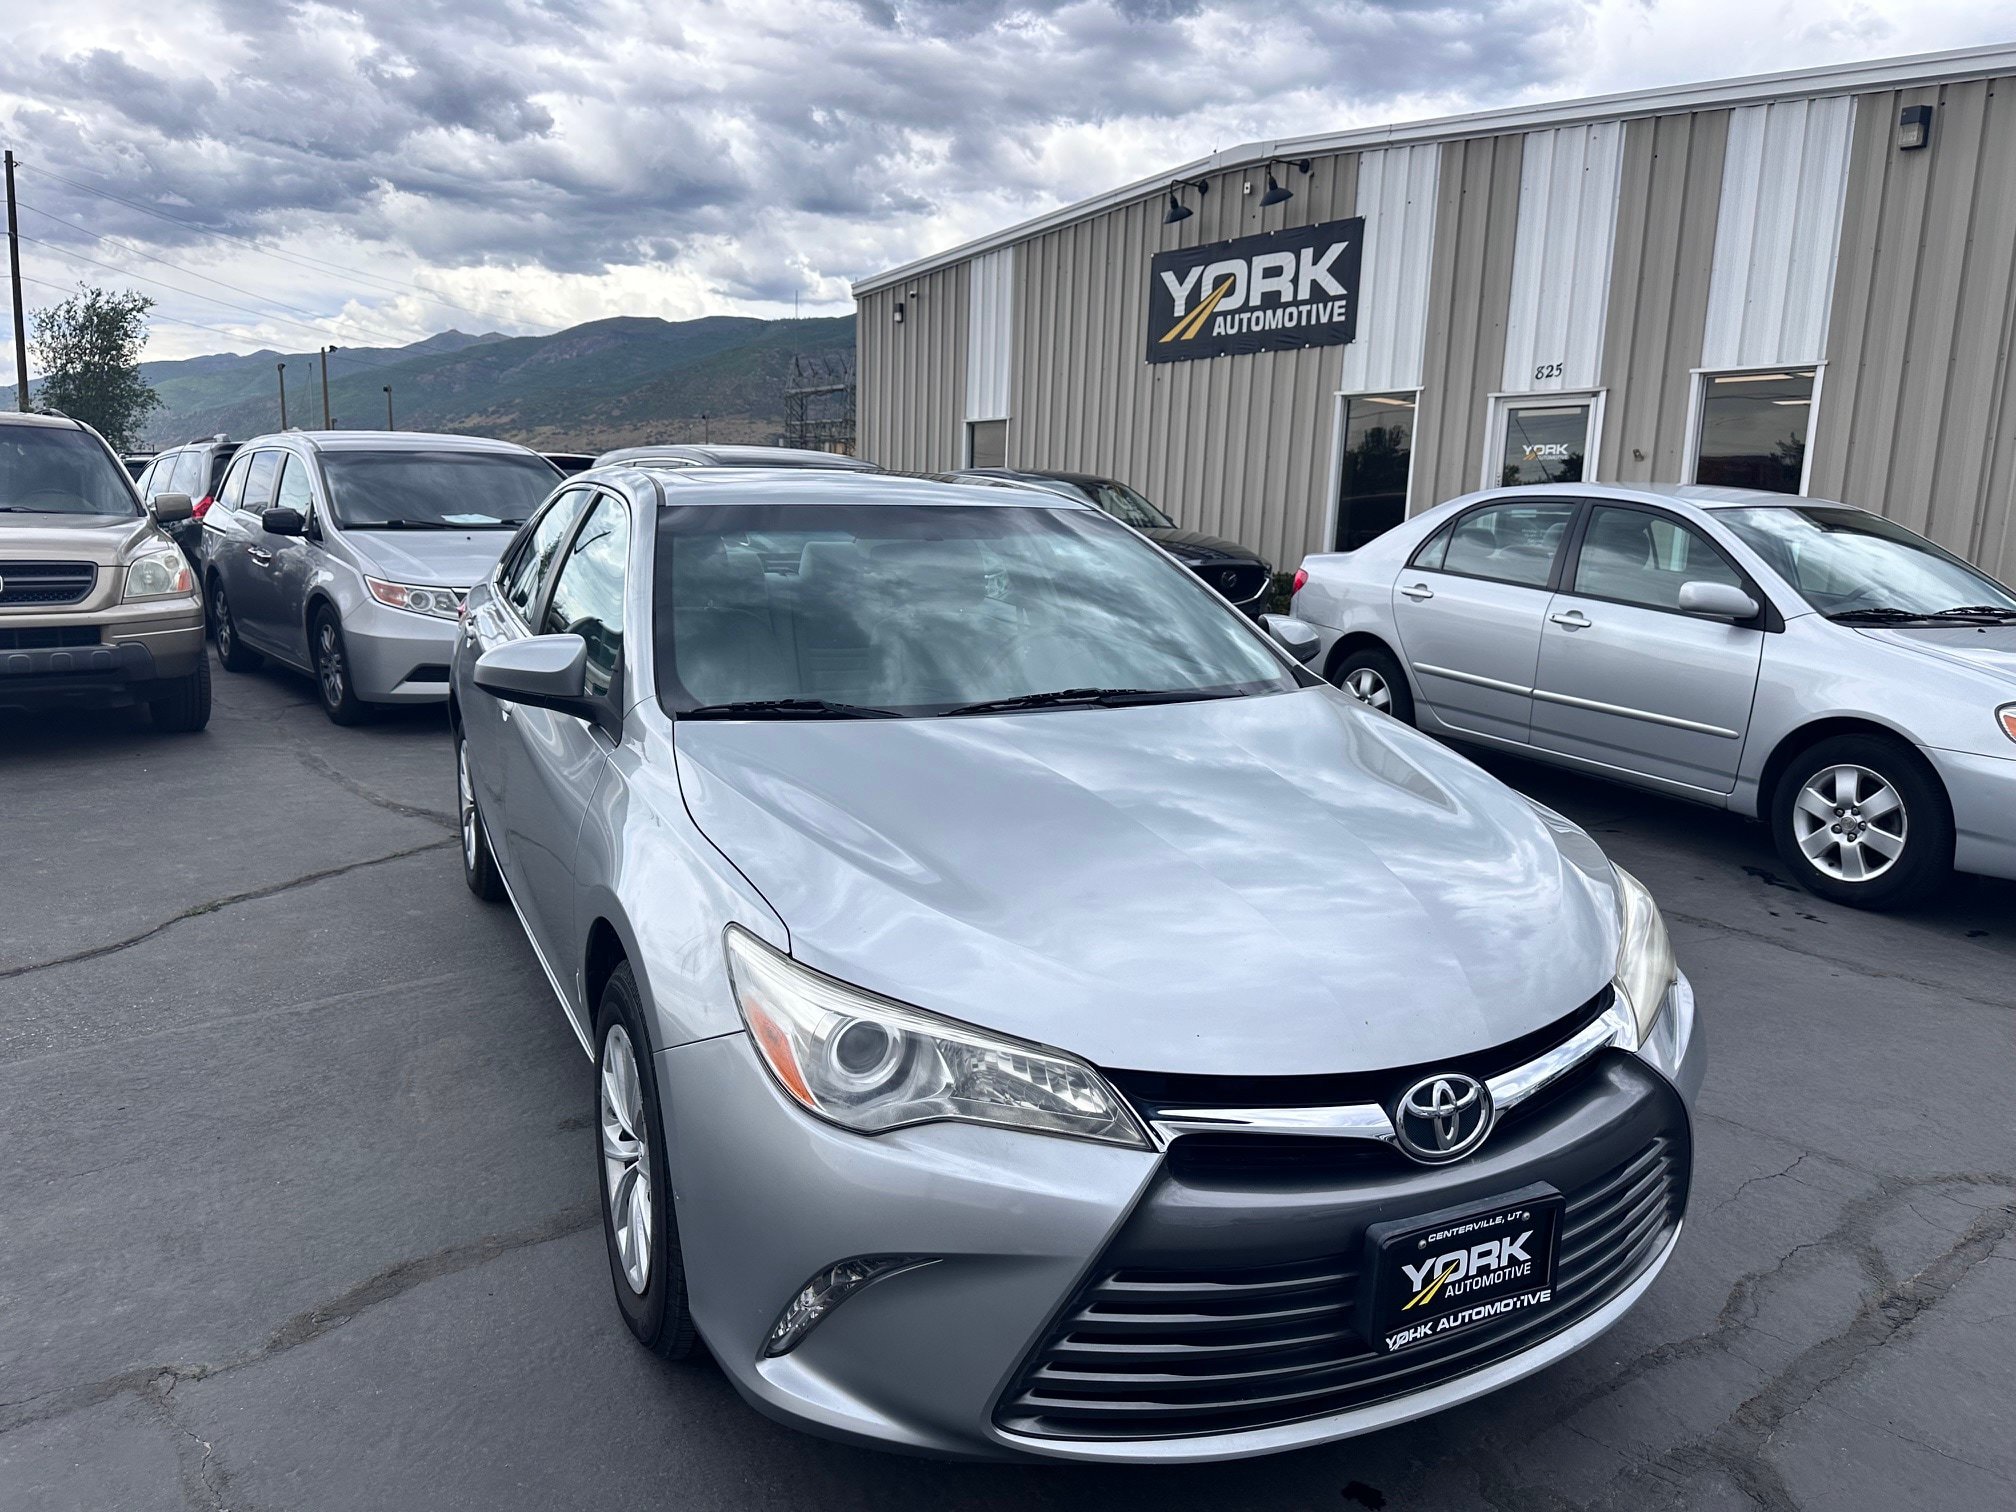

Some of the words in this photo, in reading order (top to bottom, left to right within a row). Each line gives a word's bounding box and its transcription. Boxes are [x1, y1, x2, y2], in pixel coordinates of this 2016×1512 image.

[1160, 241, 1349, 317] YORK
[1212, 300, 1347, 336] AUTOMOTIVE
[1535, 362, 1563, 380] 825
[1522, 443, 1568, 455] YORK
[1428, 1216, 1505, 1242] CENTERVILLE,
[1507, 1211, 1523, 1222] UT
[1401, 1230, 1534, 1293] YORK
[1444, 1262, 1532, 1298] AUTOMOTIVE
[1437, 1289, 1552, 1332] AUTOMOTIVE
